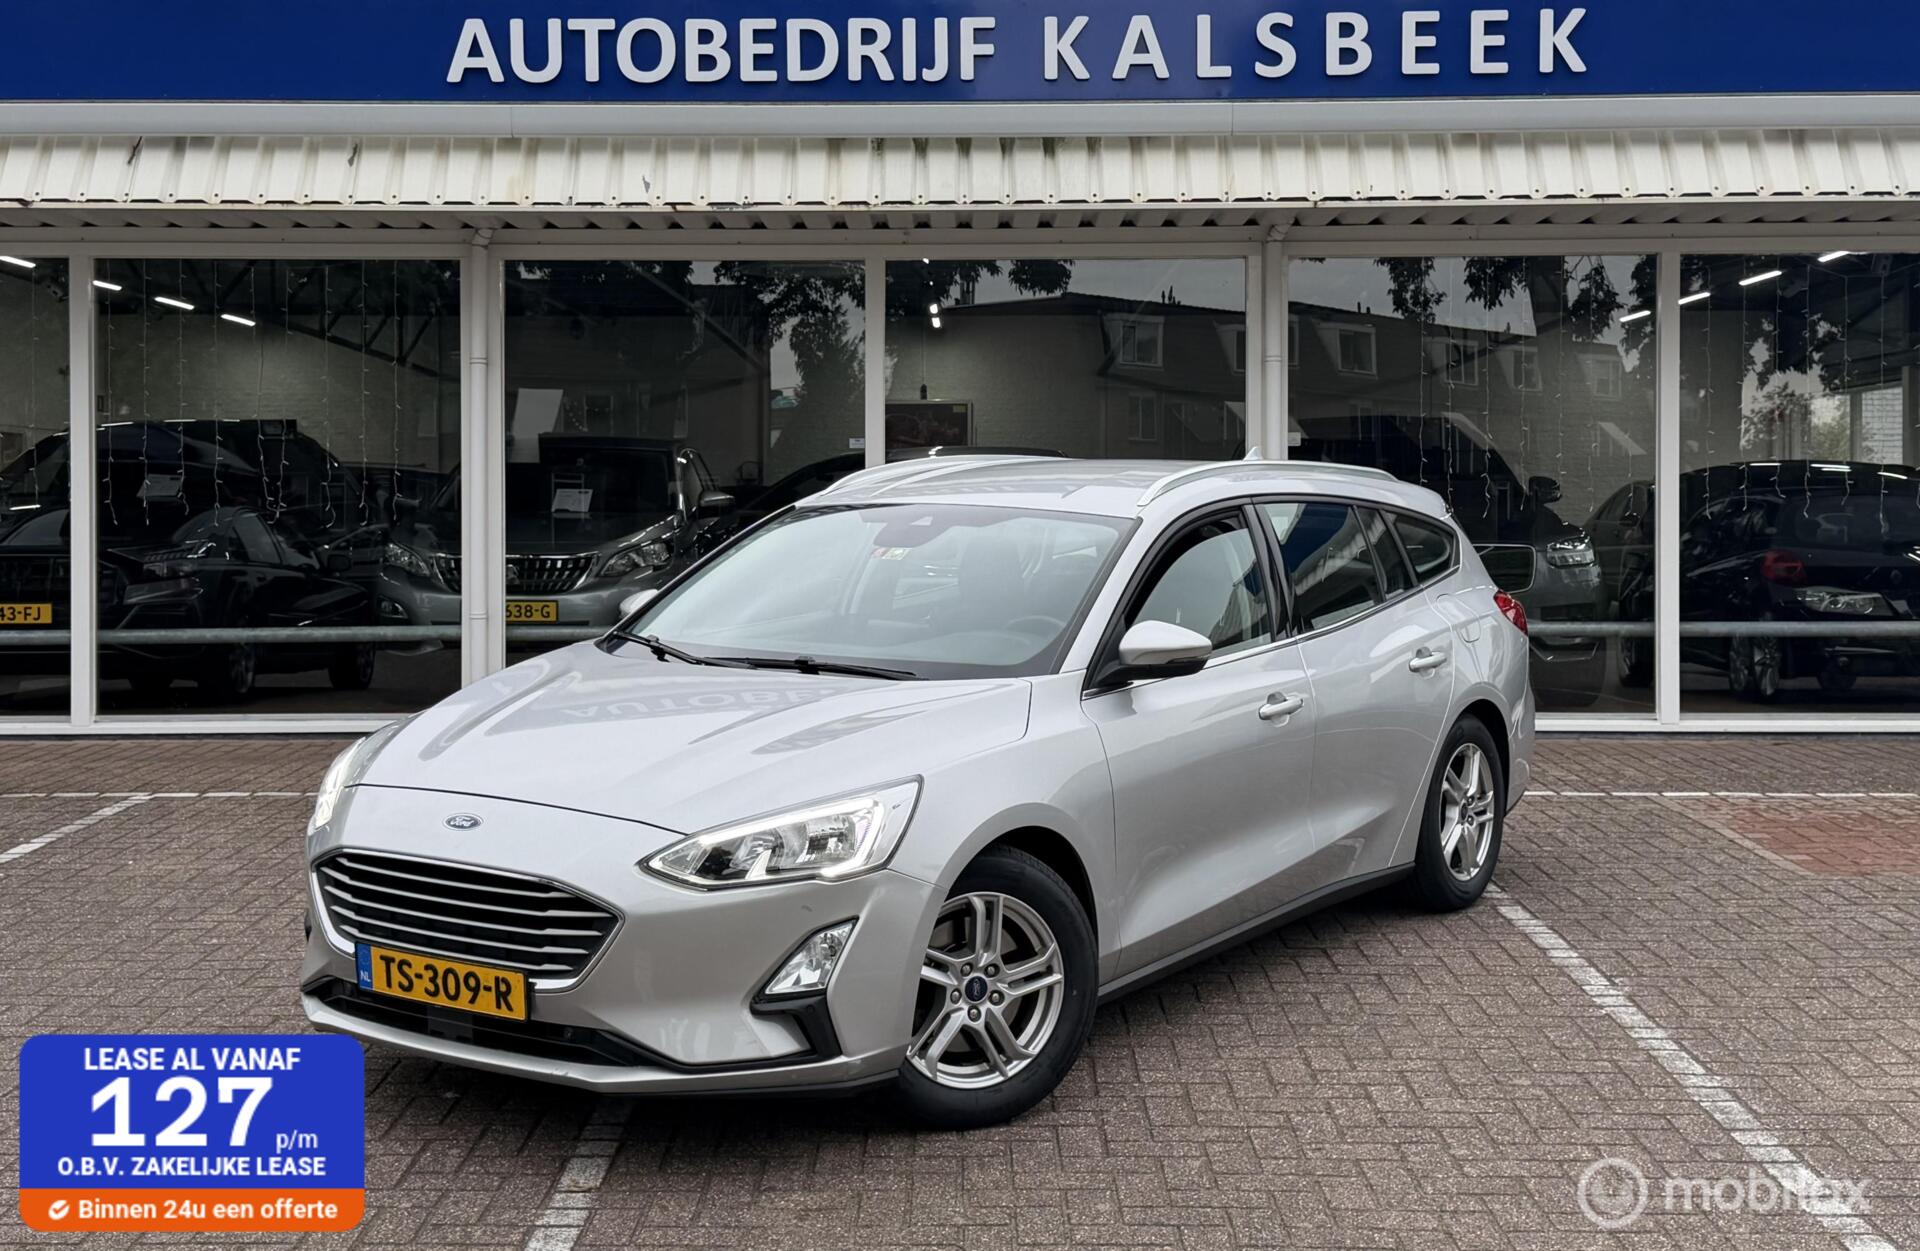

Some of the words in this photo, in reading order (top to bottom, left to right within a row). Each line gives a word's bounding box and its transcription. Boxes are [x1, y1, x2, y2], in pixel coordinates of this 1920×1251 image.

[446, 17, 996, 84] AUTOBEDRIJF
[1043, 8, 1588, 81] KALSBEEK
[360, 970, 371, 982] NL
[379, 954, 514, 1013] TS-309-R
